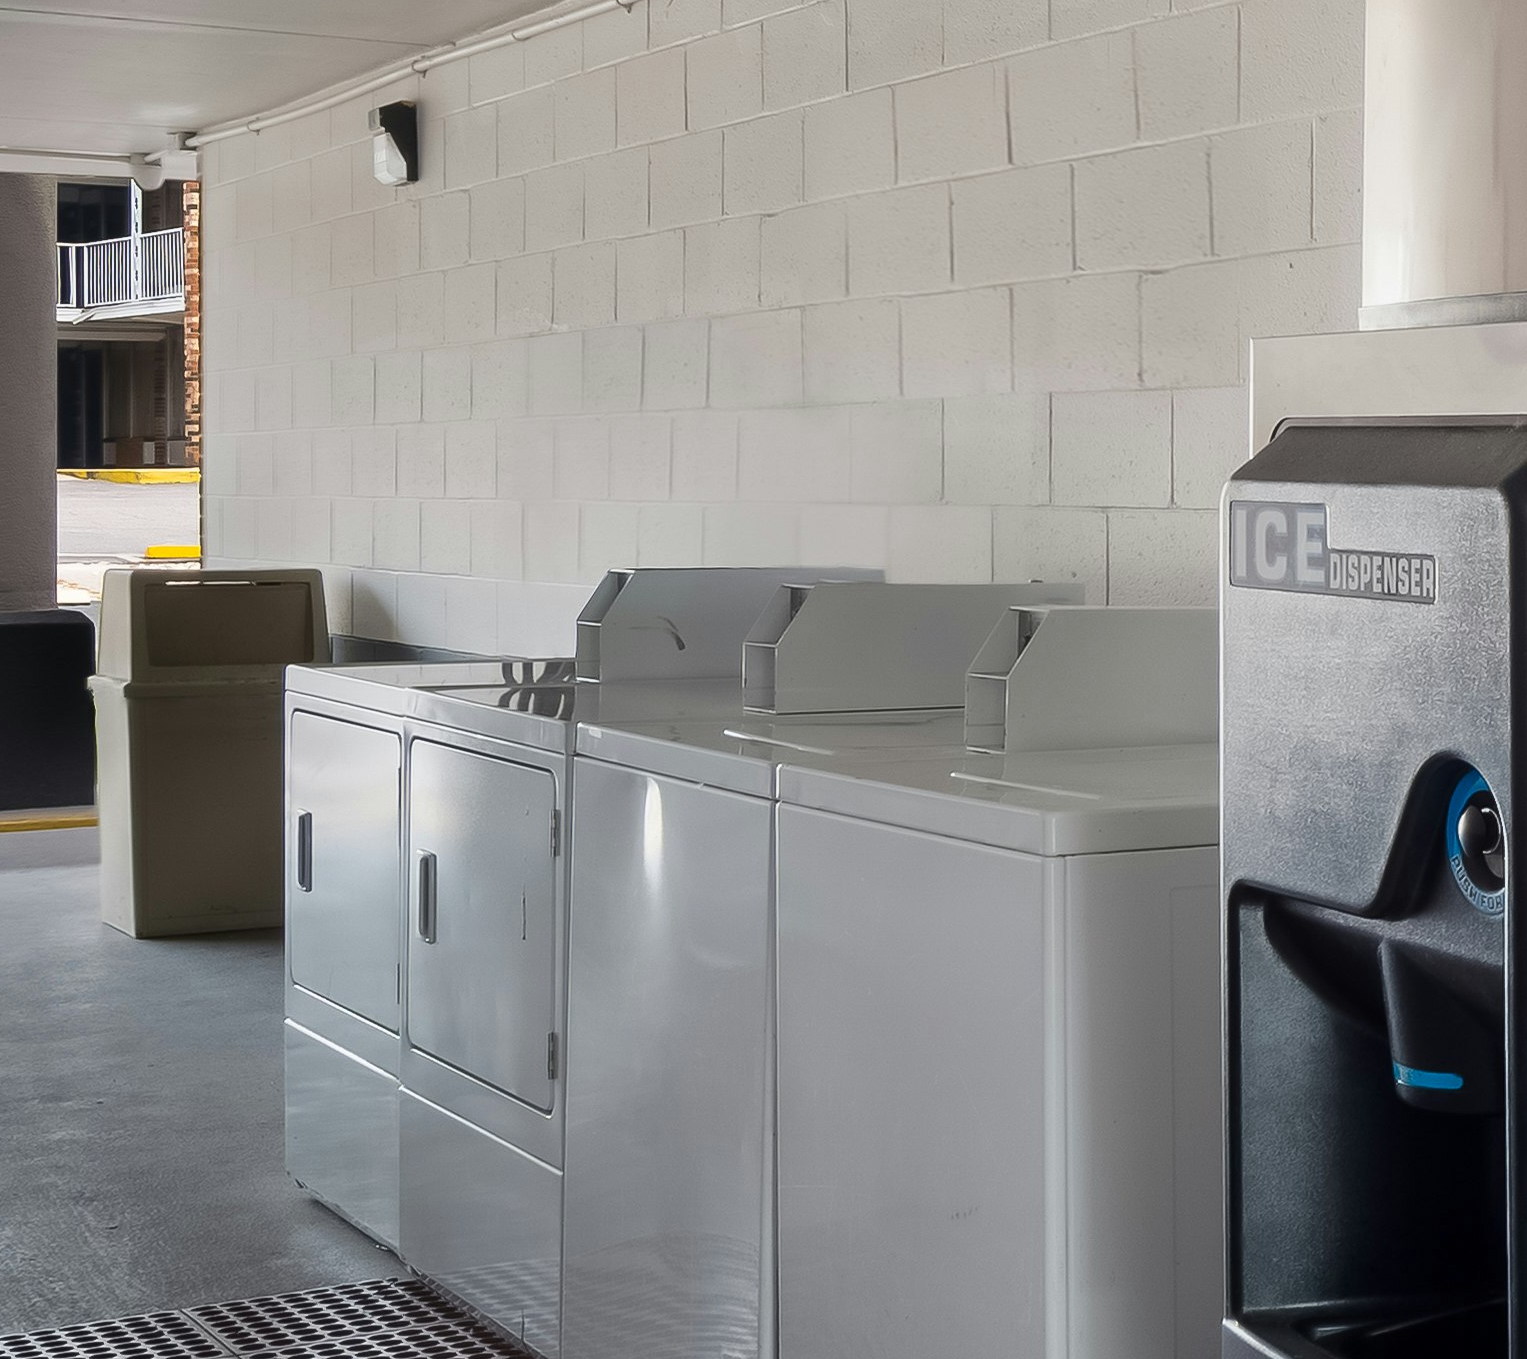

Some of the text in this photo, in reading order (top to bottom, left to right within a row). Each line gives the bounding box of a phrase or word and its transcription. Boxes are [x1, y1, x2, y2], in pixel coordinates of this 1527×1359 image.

[1235, 507, 1435, 600] ICE DISPENSER
[1451, 854, 1478, 902] PUSH
